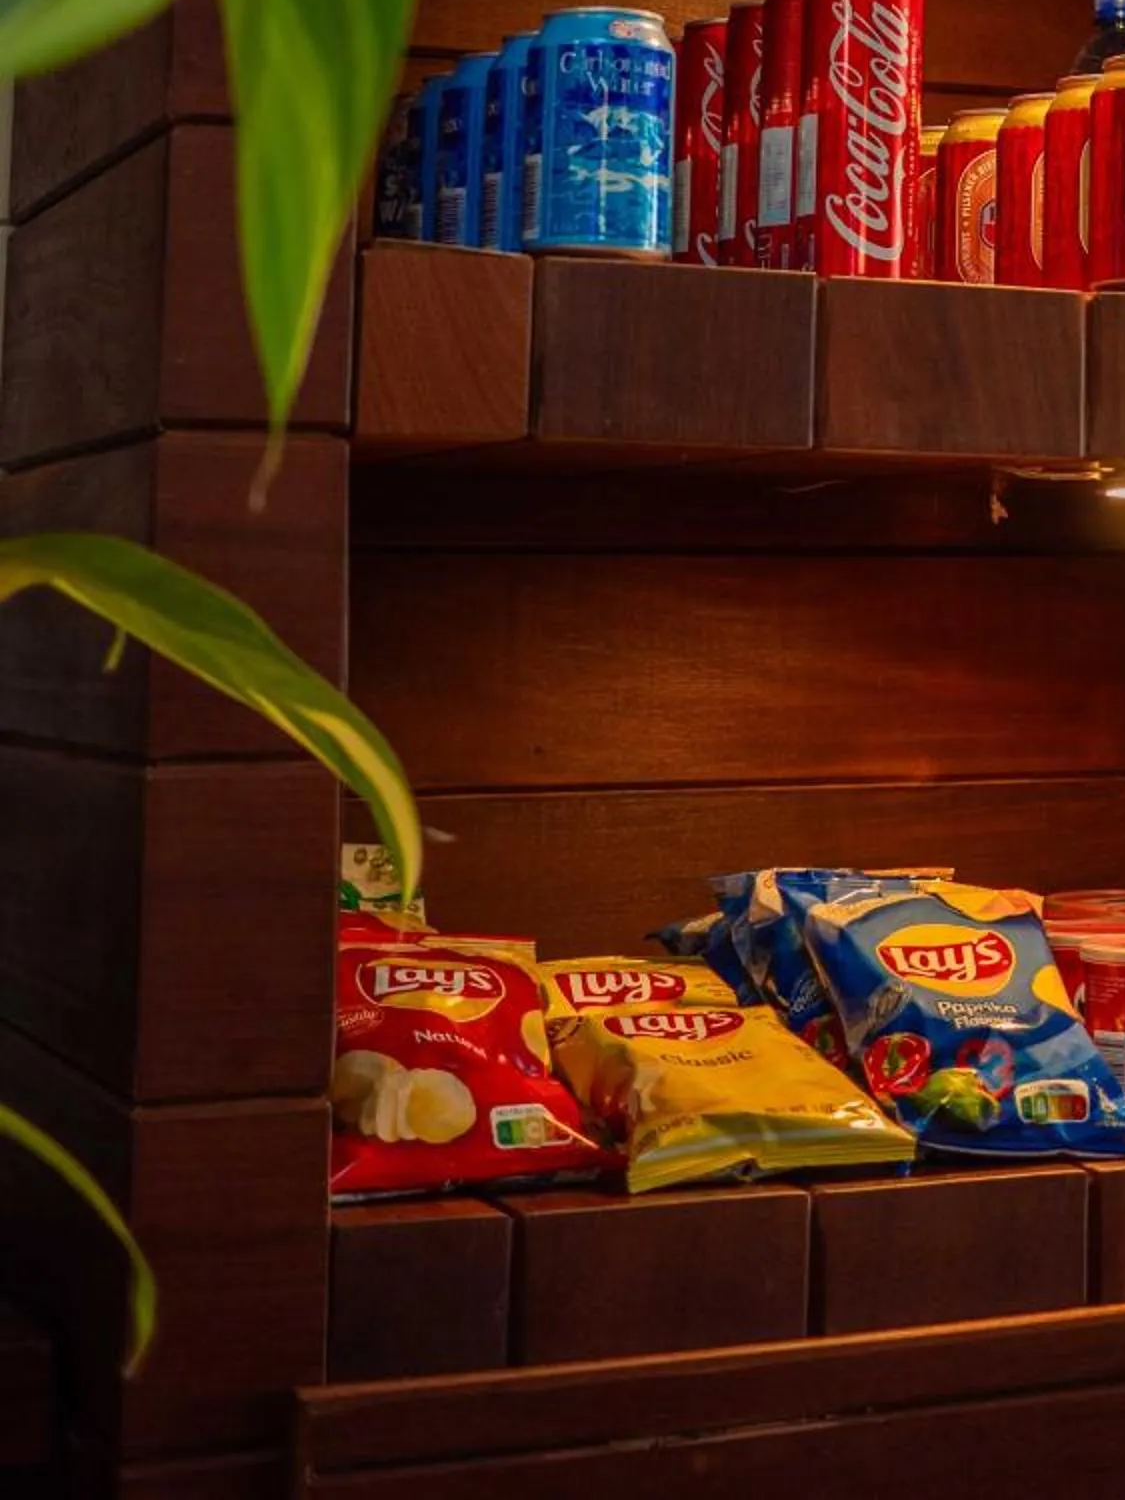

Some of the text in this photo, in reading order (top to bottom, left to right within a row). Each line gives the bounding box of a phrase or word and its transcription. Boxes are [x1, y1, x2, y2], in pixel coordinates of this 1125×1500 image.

[889, 938, 1002, 983] Lay's
[937, 1000, 1018, 1016] Paprika
[660, 1049, 754, 1069] Classic
